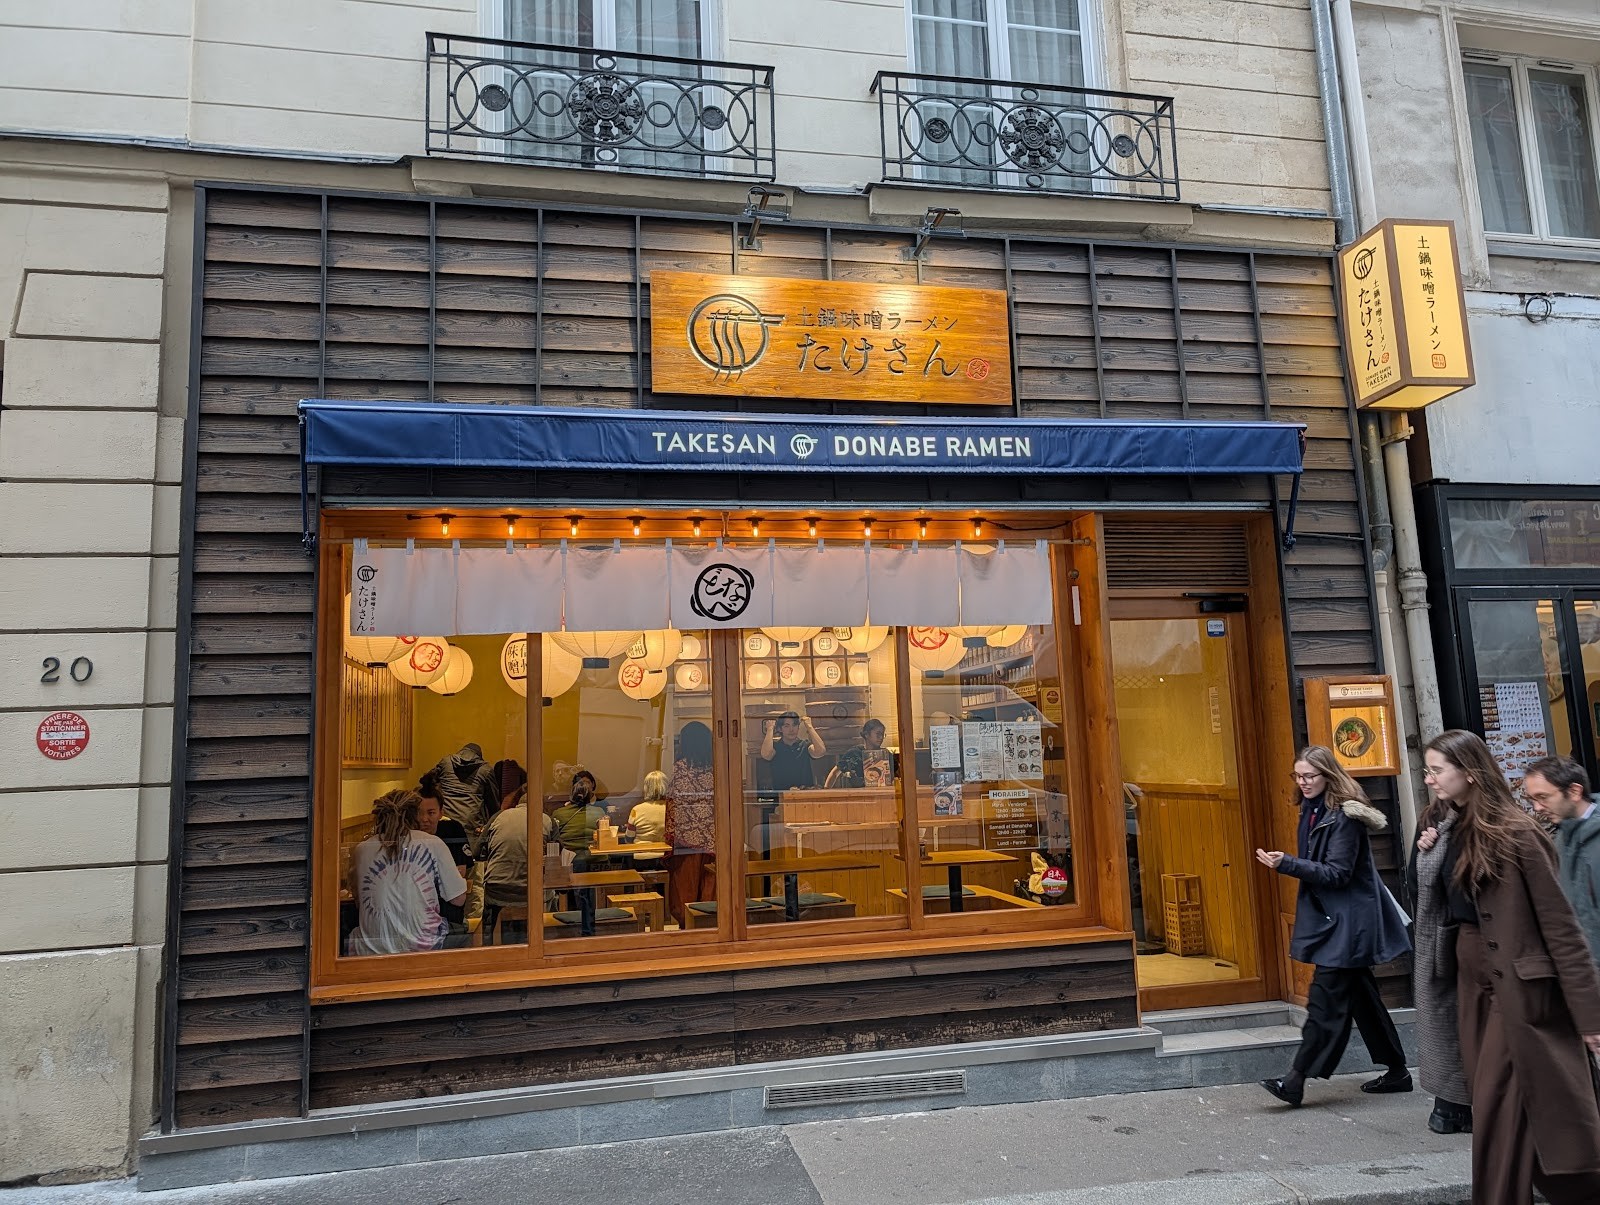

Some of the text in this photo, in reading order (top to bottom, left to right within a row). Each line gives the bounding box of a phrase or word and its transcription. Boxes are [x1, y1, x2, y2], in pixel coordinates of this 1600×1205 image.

[1417, 235, 1441, 350] 土鍋味噌ラーメン
[795, 306, 958, 332] 土鍋味噌ラーメン
[1358, 286, 1381, 371] たけさん
[797, 332, 961, 378] たけさん
[1366, 370, 1392, 388] TAKESAN
[651, 431, 1032, 458] TAKESAN DONABE RAMEN
[356, 585, 369, 632] たけさん
[40, 656, 93, 683] 20
[45, 713, 84, 725] PRIERE DE
[44, 746, 81, 758] VOITURES
